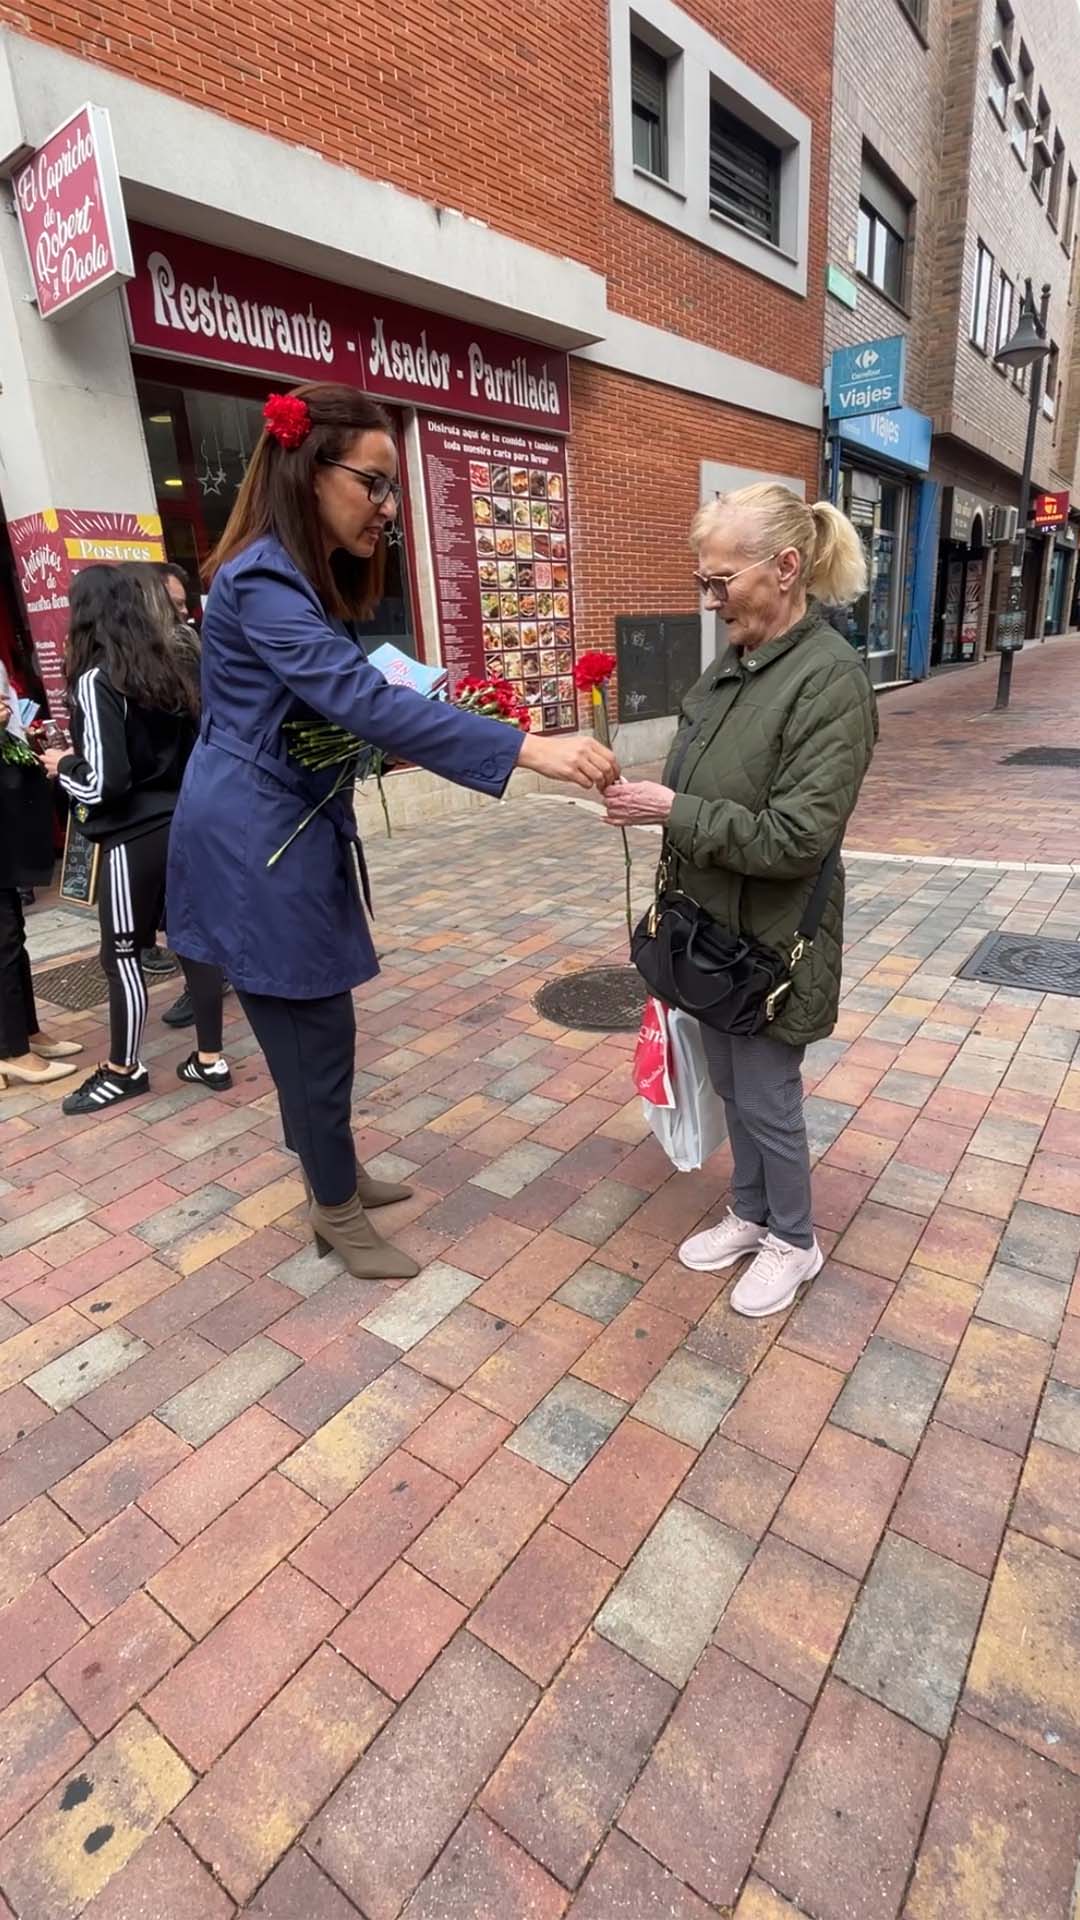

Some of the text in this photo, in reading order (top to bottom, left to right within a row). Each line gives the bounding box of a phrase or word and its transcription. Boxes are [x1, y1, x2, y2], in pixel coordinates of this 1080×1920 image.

[18, 128, 94, 212] El Capricho
[36, 195, 94, 284] Robert
[43, 202, 56, 227] de
[52, 234, 109, 300] y Paola
[147, 251, 334, 364] Restaurante
[369, 316, 451, 391] Asador
[468, 342, 561, 415] Parrillada
[840, 385, 892, 408] Viajes
[427, 420, 460, 436] Disfruta
[480, 431, 490, 442] de
[22, 543, 61, 593] Antojitos
[80, 541, 151, 560] Postres
